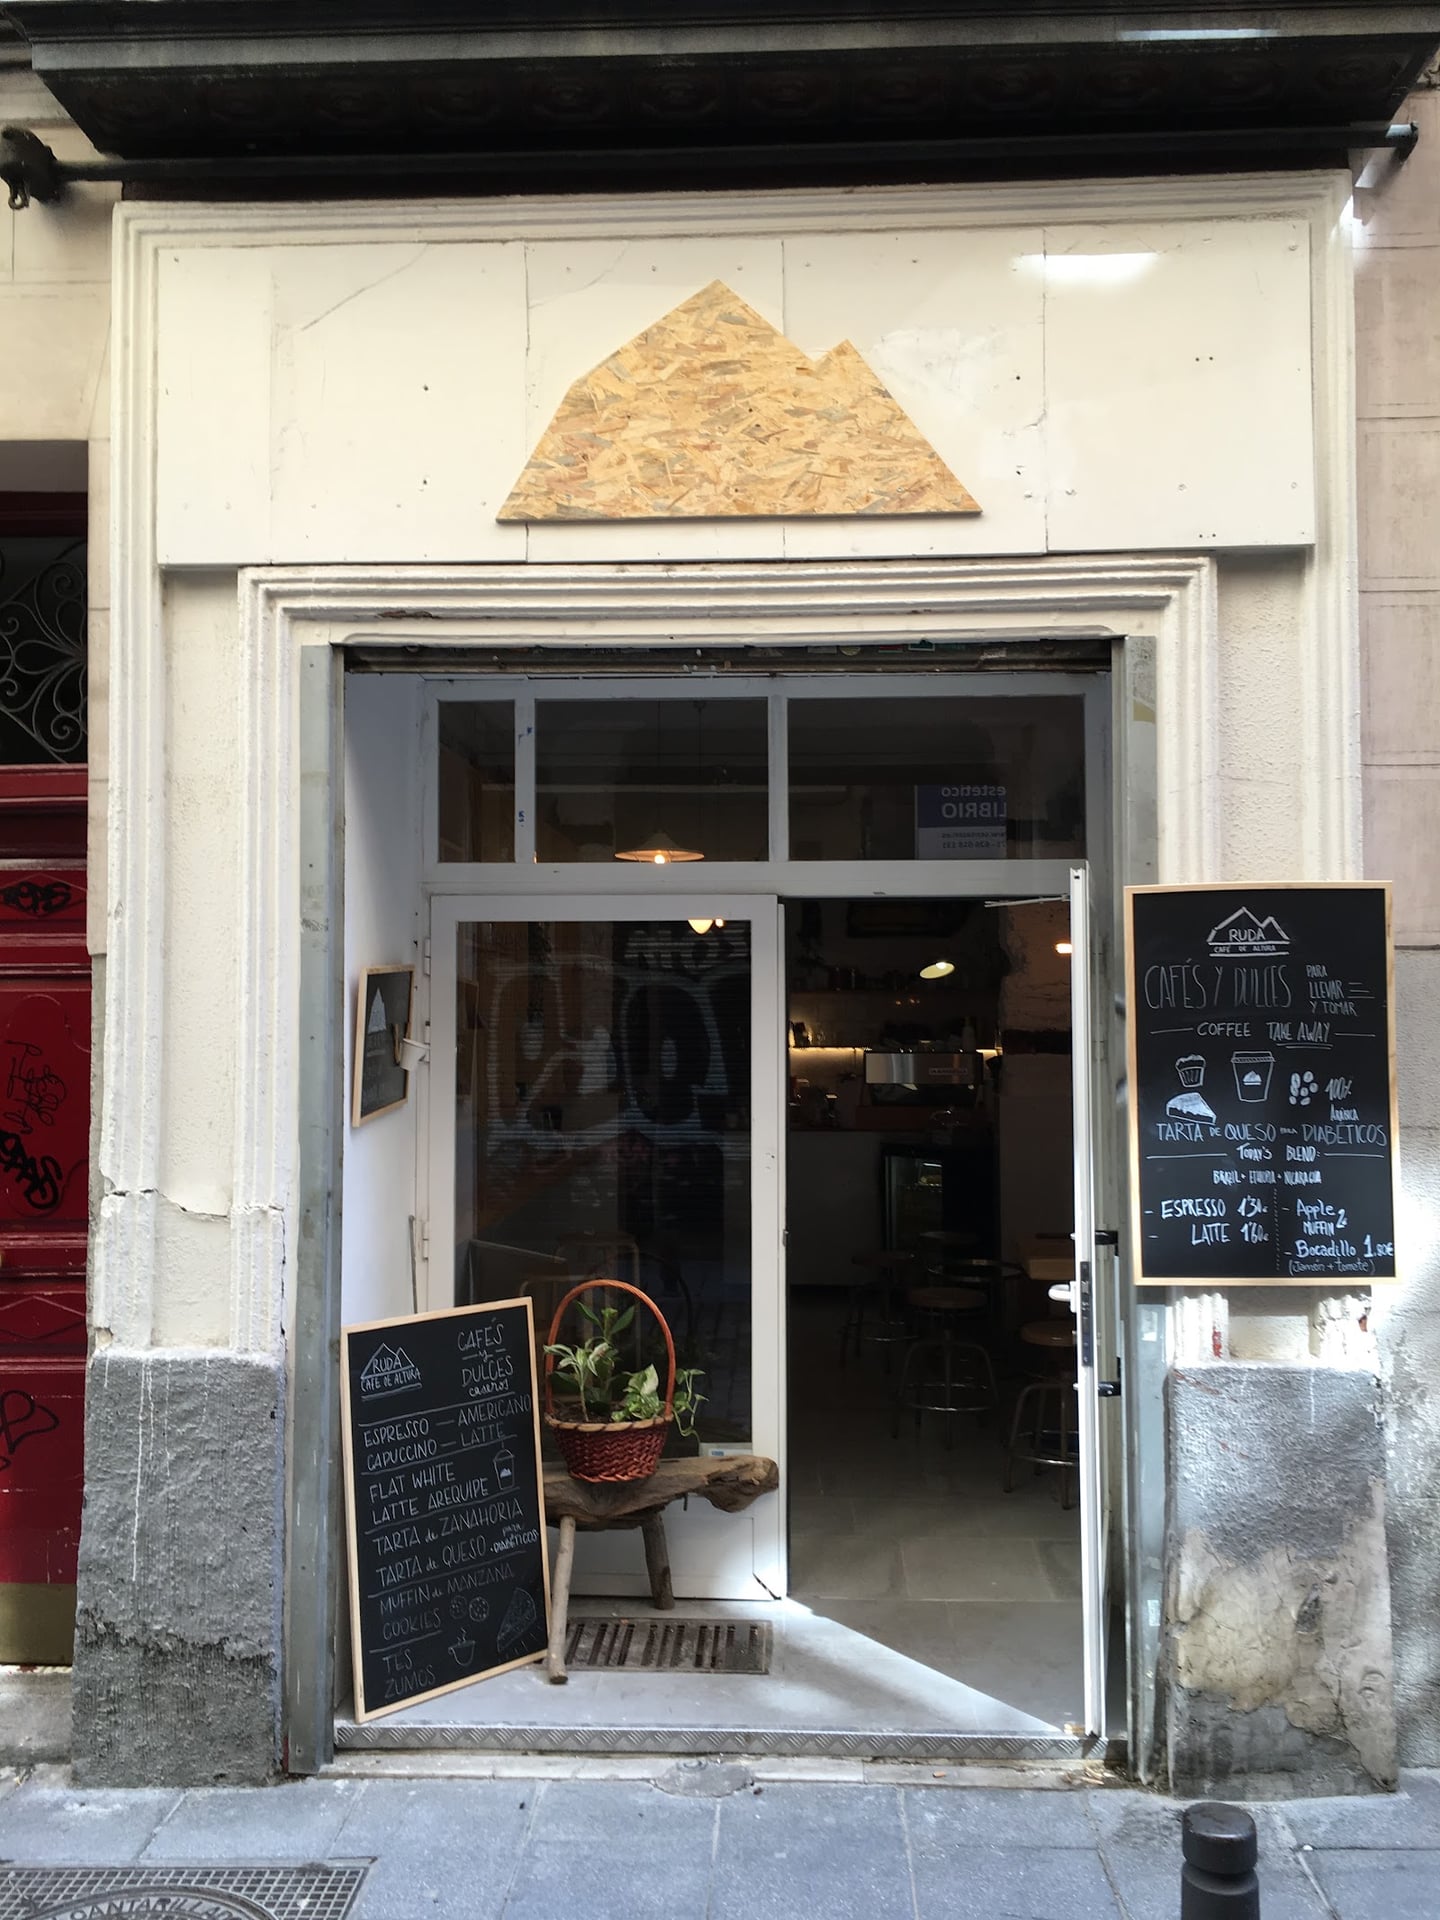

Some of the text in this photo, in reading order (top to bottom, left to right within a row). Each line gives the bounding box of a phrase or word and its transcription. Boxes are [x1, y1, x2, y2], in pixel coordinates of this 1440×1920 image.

[1228, 928, 1266, 942] RUDA
[1306, 964, 1328, 978] PARA
[1215, 966, 1224, 1007] Y
[1234, 965, 1292, 1008] DULCES
[1309, 980, 1344, 1000] LLEVAR
[1309, 1000, 1357, 1016] Y TOMAR
[1196, 1021, 1331, 1042] COFFEE TAKE AWAY
[1156, 1123, 1204, 1142] TARTA
[1209, 1127, 1222, 1137] DE
[1224, 1123, 1276, 1144] QUESO
[1161, 1199, 1226, 1219] ESPRESSO
[1296, 1199, 1336, 1220] Apple
[1191, 1223, 1231, 1246] LATTE
[1303, 1221, 1335, 1236] MUFFIN
[1295, 1240, 1356, 1258] Bocadillo
[372, 1356, 402, 1374] RUDA
[394, 1367, 421, 1384] ALTURA
[461, 1355, 514, 1388] DULCES
[468, 1379, 509, 1397] caseros
[363, 1394, 532, 1448] ESPRESSO AMERICANO
[367, 1421, 506, 1472] CAPUCCINO LATTE
[369, 1462, 456, 1504] FLAT WHITE
[372, 1477, 489, 1525] LATTE AREQUIPE
[372, 1498, 523, 1556] TARTA de ZANAHORIA
[376, 1535, 487, 1588] TARTA de QUESO
[380, 1584, 430, 1616] MUFFIN
[447, 1562, 515, 1592] MANZANA
[383, 1608, 442, 1641] COOKIES
[384, 1664, 437, 1699] ZUMOS
